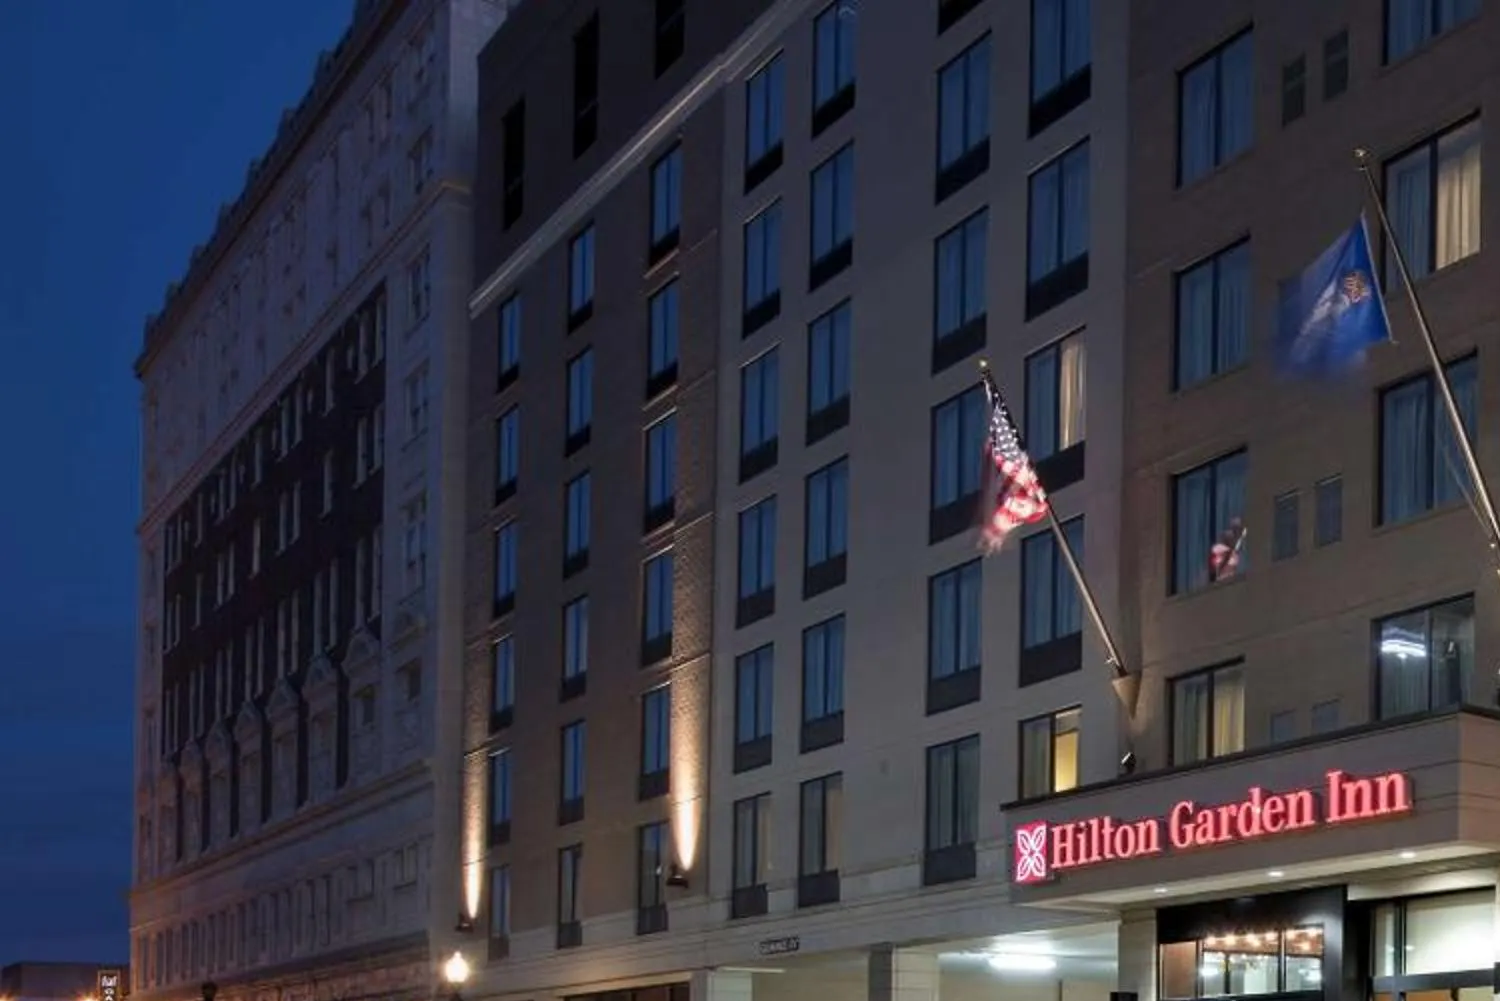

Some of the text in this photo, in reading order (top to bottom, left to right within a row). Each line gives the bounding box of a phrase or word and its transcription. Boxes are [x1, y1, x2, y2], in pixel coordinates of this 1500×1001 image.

[1051, 769, 1409, 869] Hilton Garden Inn
